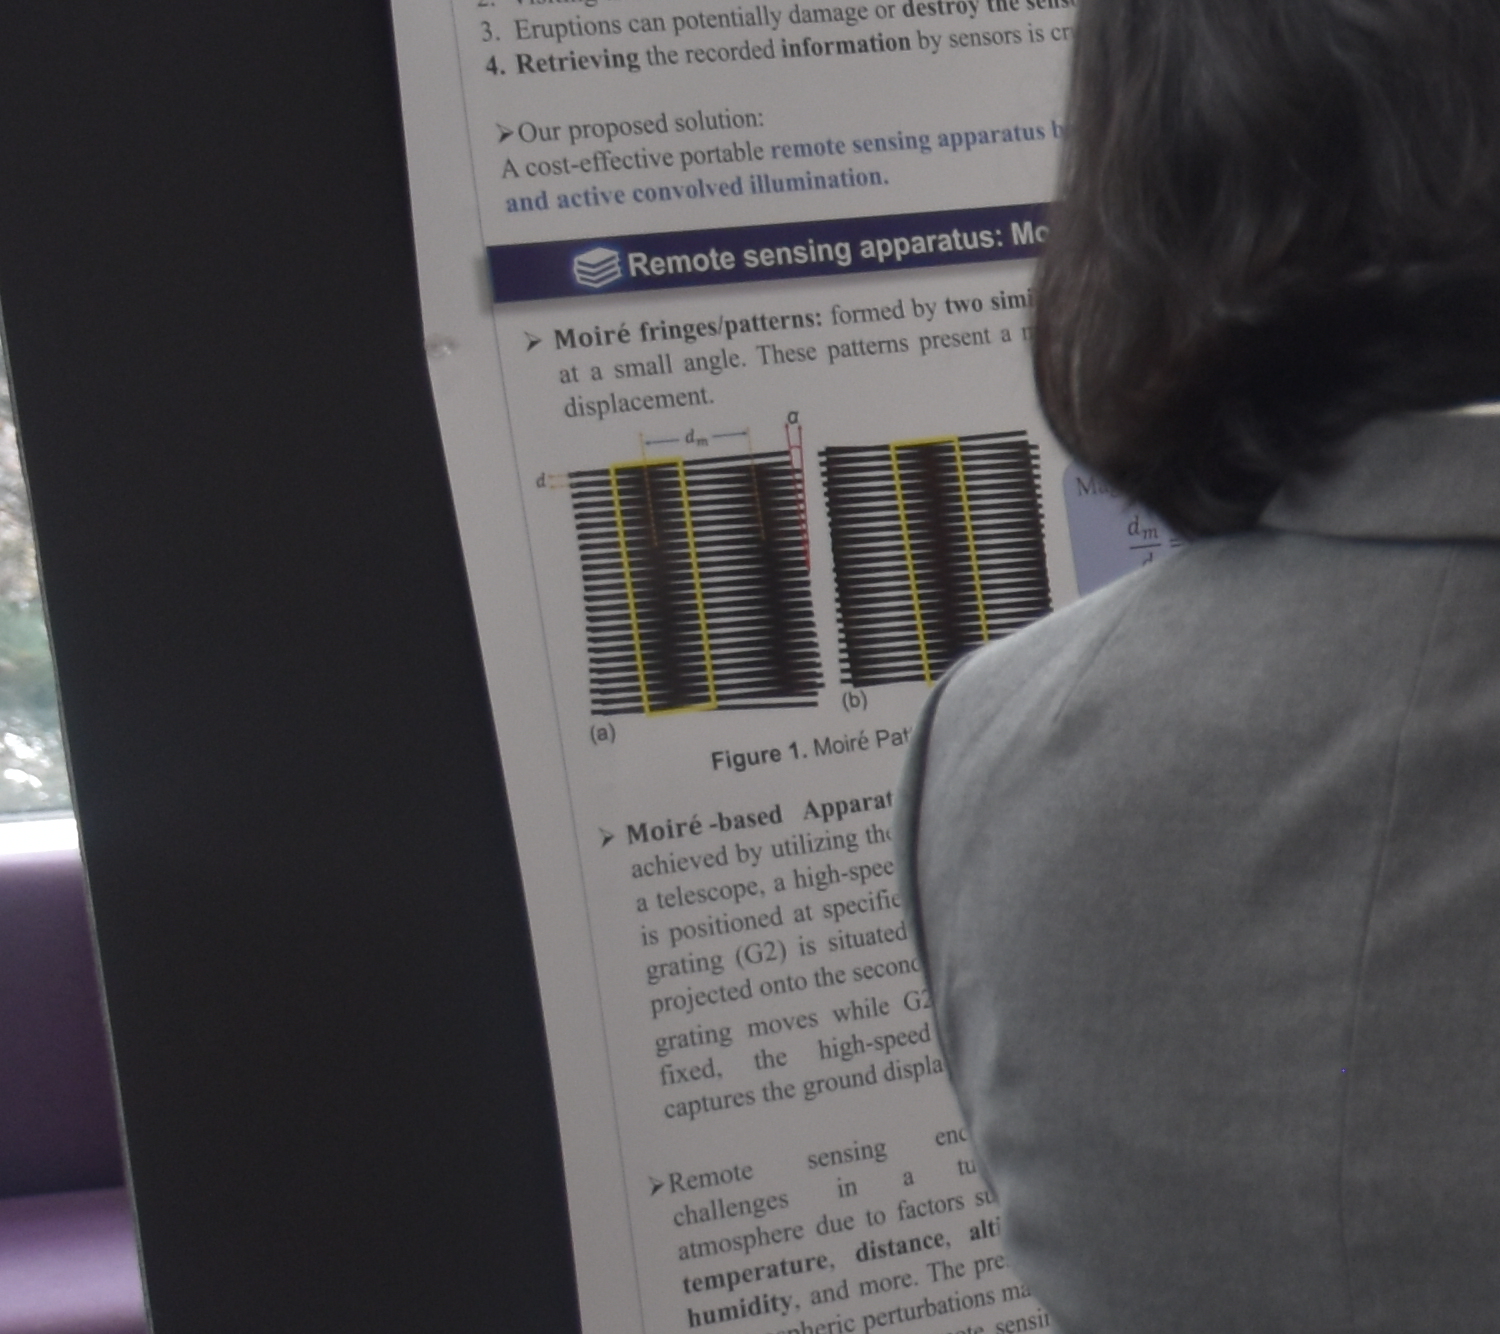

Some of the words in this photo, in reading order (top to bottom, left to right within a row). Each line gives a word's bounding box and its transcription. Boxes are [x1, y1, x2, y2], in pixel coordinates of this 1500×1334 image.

[628, 248, 735, 277] Remote
[743, 239, 852, 268] sensing
[860, 229, 1003, 263] apparatus:
[711, 748, 781, 772] Figure
[789, 741, 807, 759] 1.
[814, 730, 869, 756] Moiré
